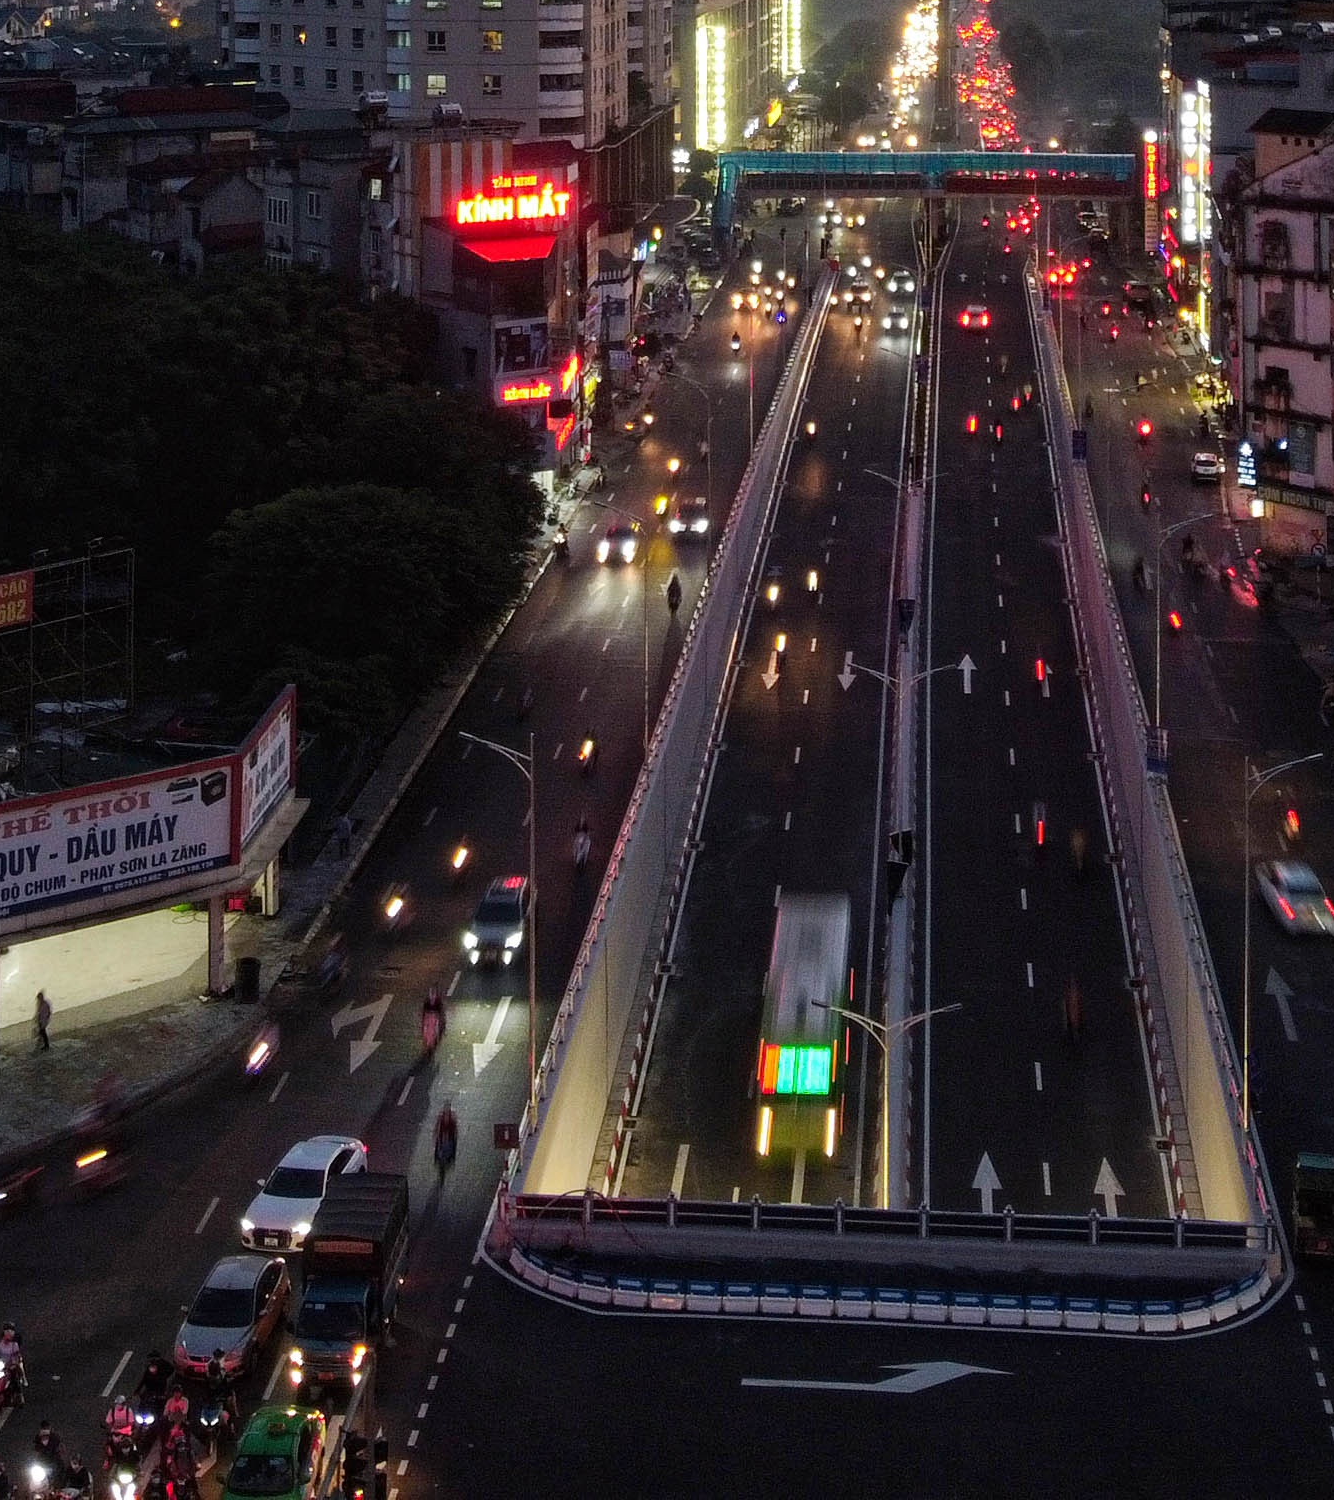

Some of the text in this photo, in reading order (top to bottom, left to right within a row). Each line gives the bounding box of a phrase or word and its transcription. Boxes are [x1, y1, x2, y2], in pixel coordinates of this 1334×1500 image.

[457, 182, 570, 224] KÍNH MẮT
[63, 789, 152, 825] THỜI
[67, 822, 116, 865] DẦU
[125, 810, 178, 851] MÁY
[80, 864, 116, 884] PHAY
[119, 857, 148, 875] SƠN
[152, 851, 168, 867] LA
[171, 842, 207, 863] ZĂNG
